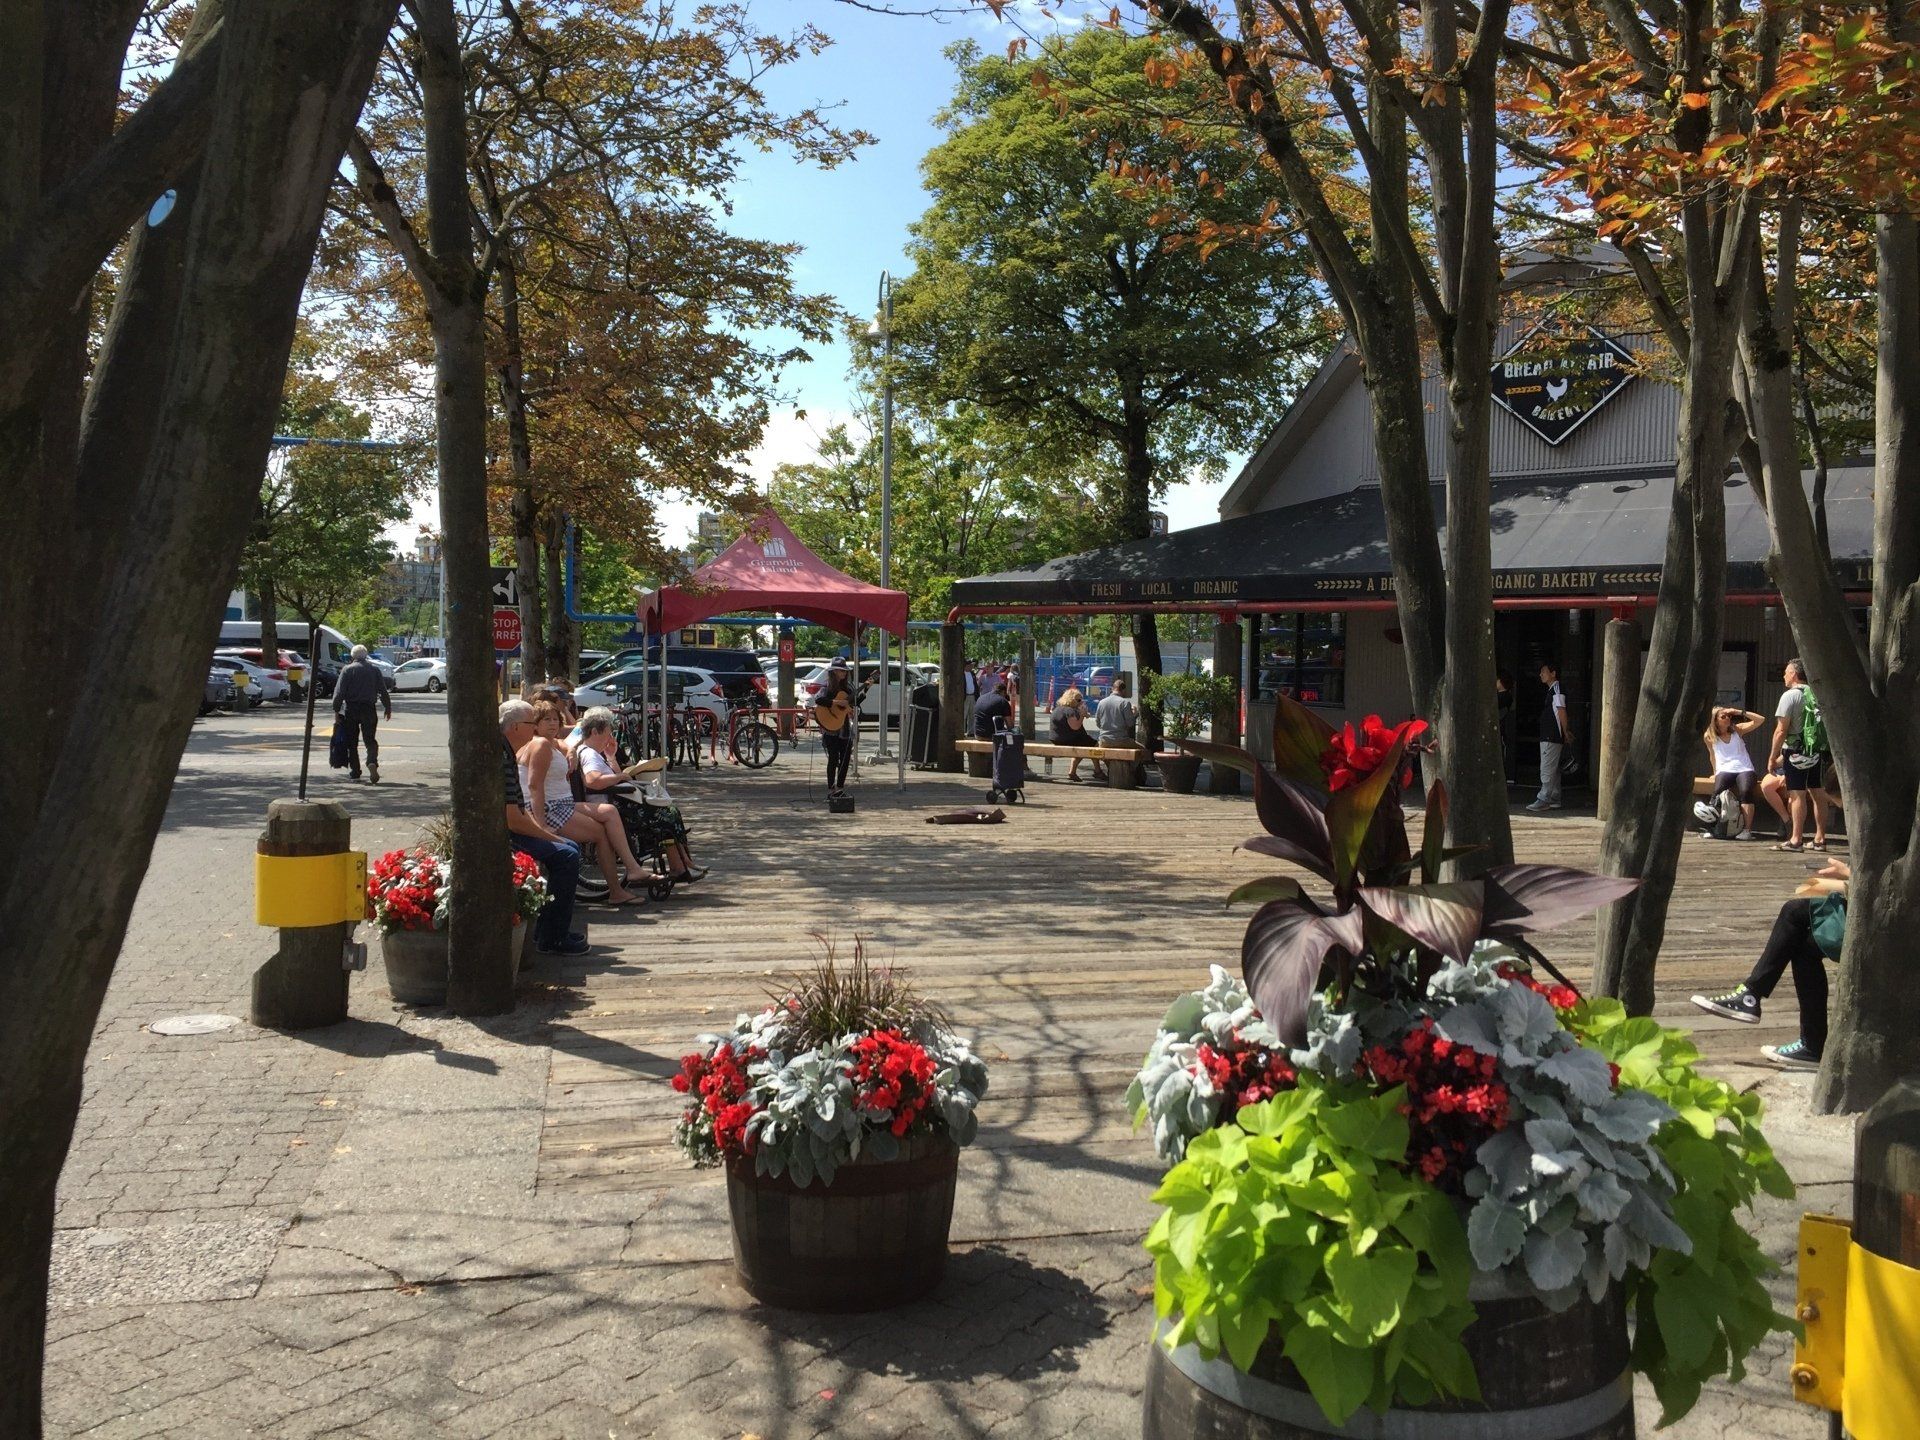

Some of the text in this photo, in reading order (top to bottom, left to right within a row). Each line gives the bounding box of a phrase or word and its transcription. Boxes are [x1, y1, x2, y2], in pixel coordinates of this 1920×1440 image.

[1504, 353, 1615, 378] BREAD AFAIR
[1532, 405, 1581, 420] BAKERY
[1091, 581, 1239, 597] FRESH LOCAL ORGANIC
[1367, 572, 1597, 591] A BR GANIC BAKERY
[493, 618, 518, 628] STOP
[493, 629, 521, 640] RRÊT
